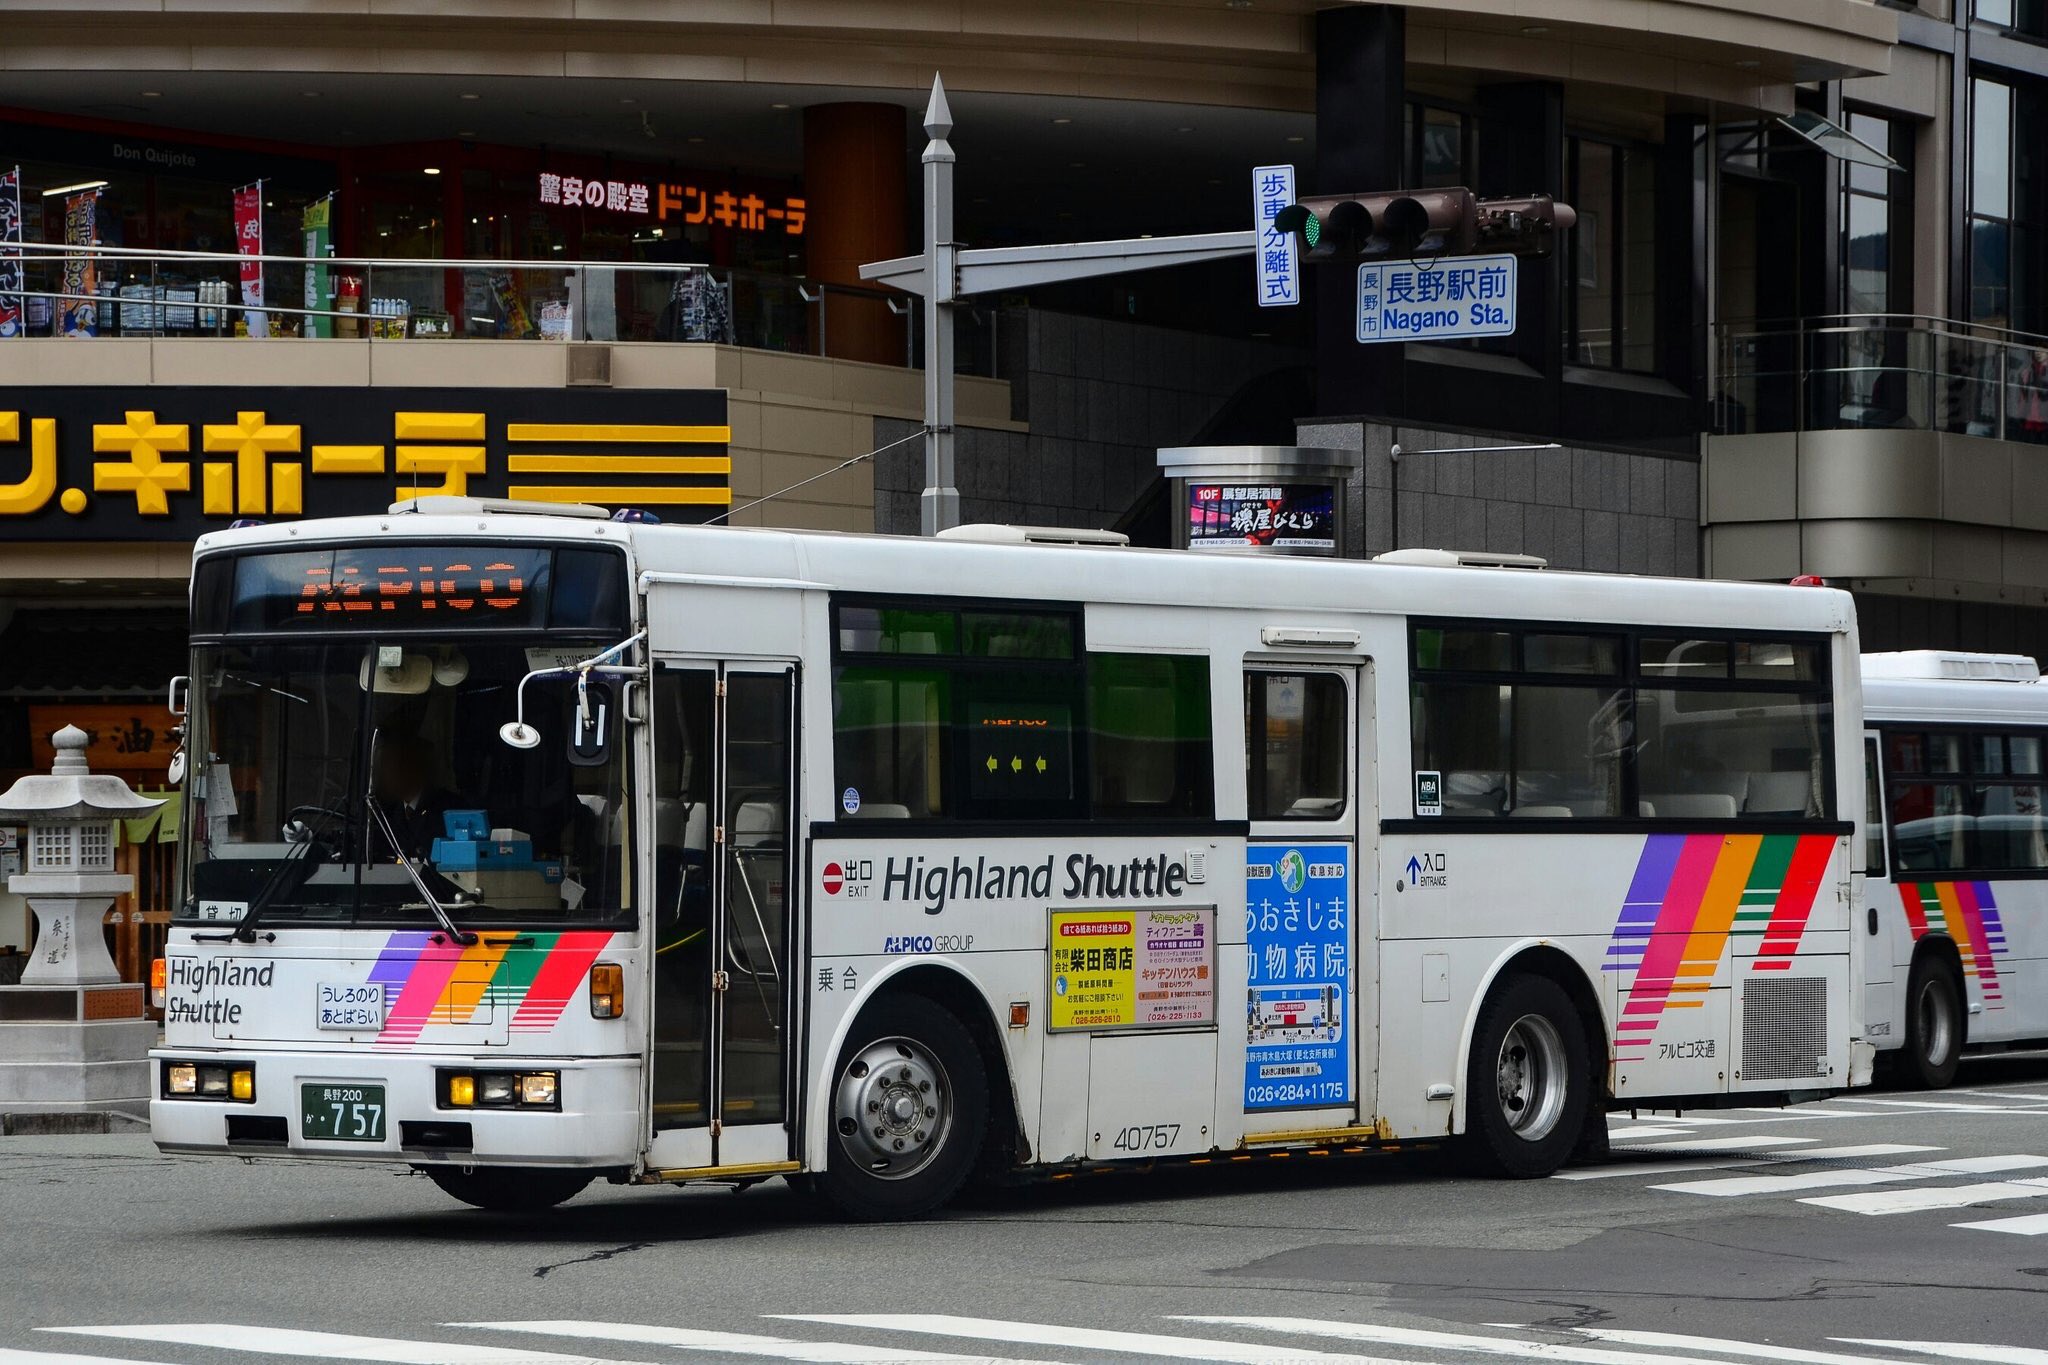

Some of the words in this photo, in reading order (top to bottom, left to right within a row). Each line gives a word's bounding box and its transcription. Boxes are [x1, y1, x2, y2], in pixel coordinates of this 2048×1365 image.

[113, 143, 141, 160] Don
[145, 148, 197, 167] Quijote
[539, 173, 650, 213] 驚安の殿堂
[1261, 173, 1291, 299] 歩車分離式
[1386, 266, 1508, 305] 長野駅前
[1362, 272, 1378, 333] 長野市
[1383, 308, 1459, 333] Nagano
[1470, 303, 1509, 326] Sta.
[1199, 489, 1219, 500] 10F
[1420, 781, 1436, 791] NBA
[845, 859, 873, 881] 出口
[1423, 853, 1446, 872] 入口
[848, 885, 869, 897] EXIT
[882, 855, 1054, 915] Highland
[1063, 853, 1185, 898] Shuttle
[1420, 876, 1447, 887] ENTRANCE
[884, 936, 933, 953] ALPICO
[934, 934, 974, 951] GROUP
[1070, 946, 1133, 972] 柴田商店
[170, 959, 275, 993] Highland
[818, 965, 858, 992] 乗合
[322, 987, 379, 1003] うしろのり
[168, 997, 242, 1024] Shuttle
[321, 1009, 379, 1025] あとばらい
[1659, 1039, 1715, 1060] アルピコ交通
[1114, 1123, 1181, 1151] 40757
